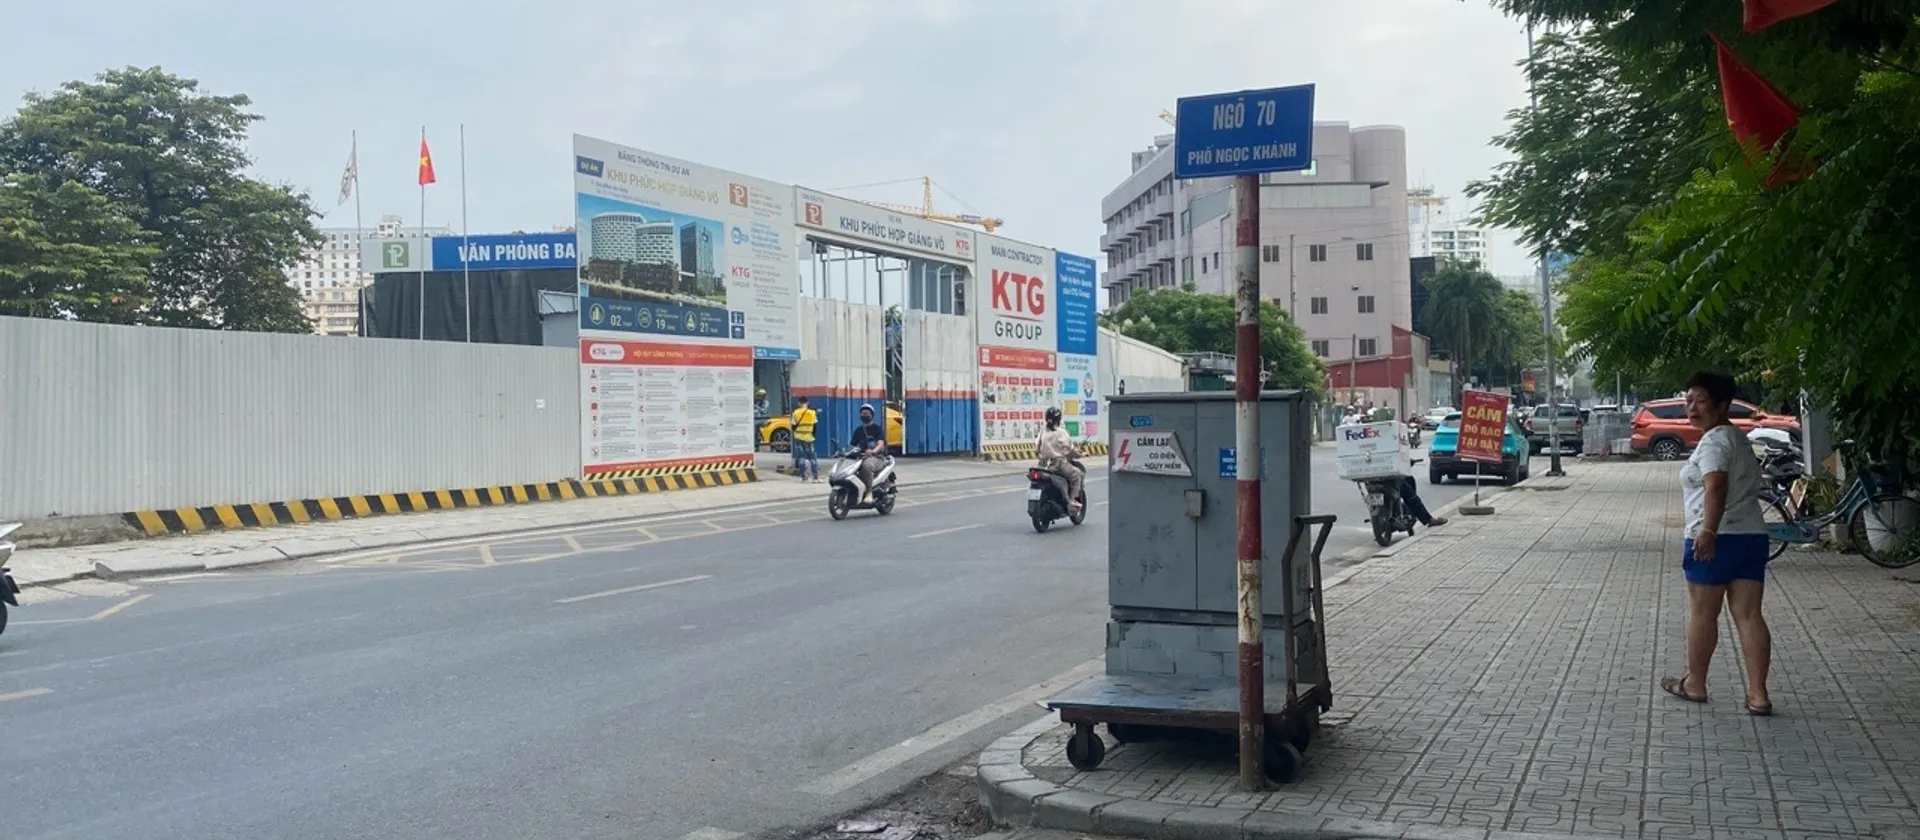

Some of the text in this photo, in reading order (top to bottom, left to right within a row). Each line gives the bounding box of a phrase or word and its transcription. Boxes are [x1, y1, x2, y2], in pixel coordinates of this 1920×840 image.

[1213, 99, 1276, 130] NGÕ 70
[1188, 140, 1297, 166] PHỐ NGỌC KHÁNH
[607, 168, 627, 184] KHU
[840, 216, 859, 232] KHU
[458, 242, 490, 262] VĂN
[495, 240, 550, 261] PHÒNG
[991, 245, 1006, 258] MAIN
[1007, 248, 1044, 266] CONTRACTOR
[732, 265, 750, 278] KTG
[991, 268, 1045, 316] KTG
[611, 315, 622, 326] 02
[656, 318, 666, 329] 19
[699, 322, 709, 333] 21
[994, 320, 1042, 340] GROUP
[1467, 404, 1503, 422] CẤM
[1345, 428, 1381, 441] FedEx
